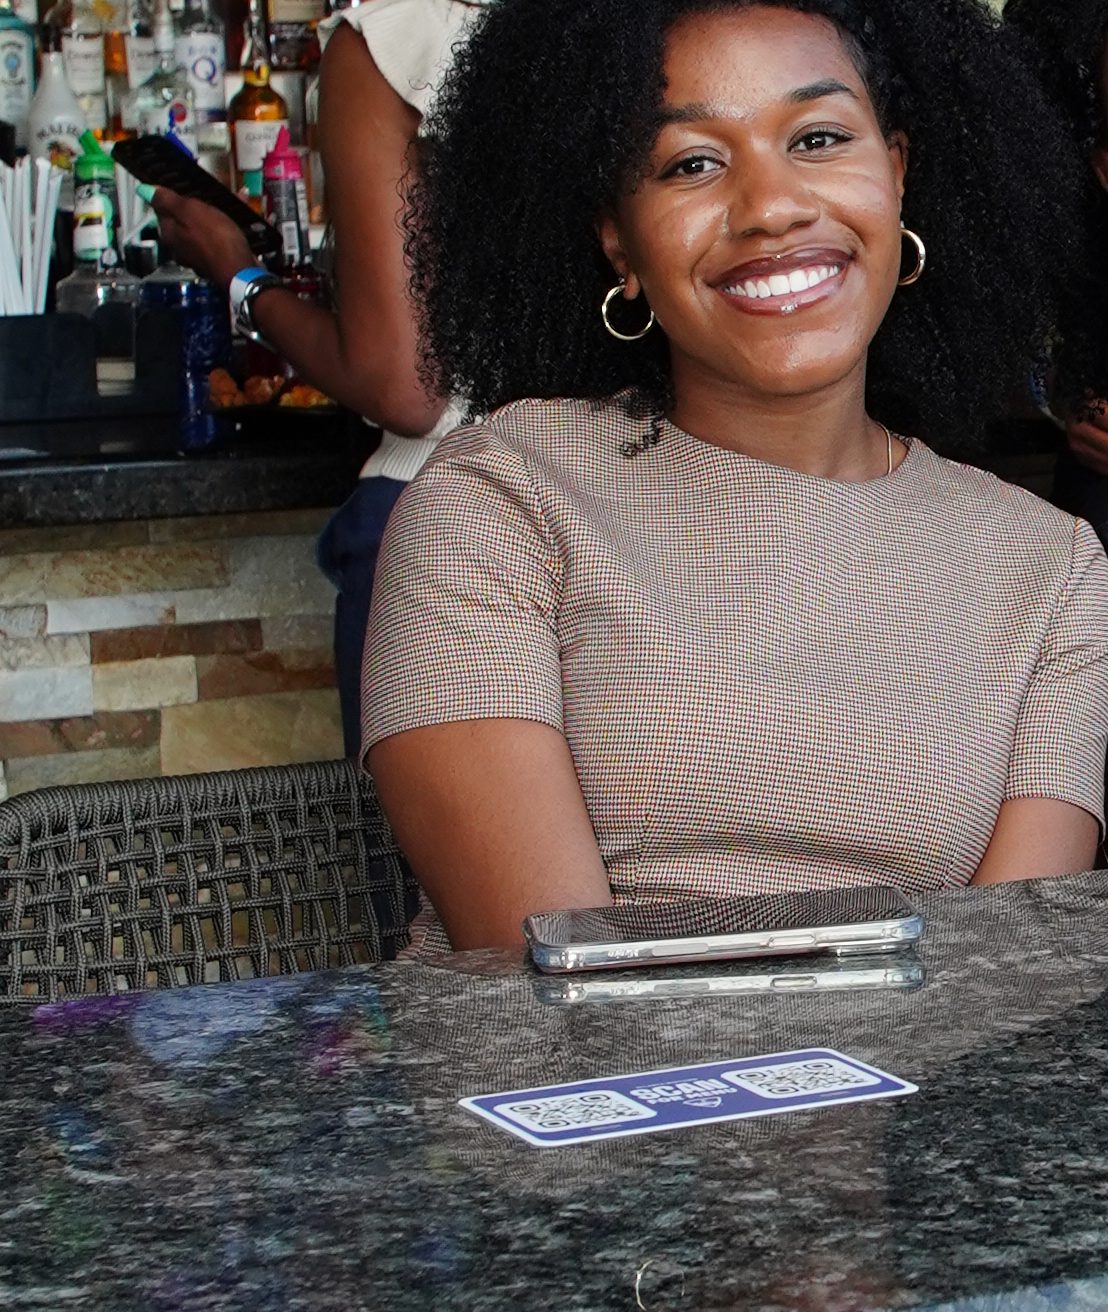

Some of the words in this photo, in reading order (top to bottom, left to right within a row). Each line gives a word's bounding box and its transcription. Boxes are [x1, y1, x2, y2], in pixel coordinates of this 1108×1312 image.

[193, 57, 217, 87] Q
[630, 1078, 729, 1100] SCAN
[685, 1088, 738, 1099] MENU
